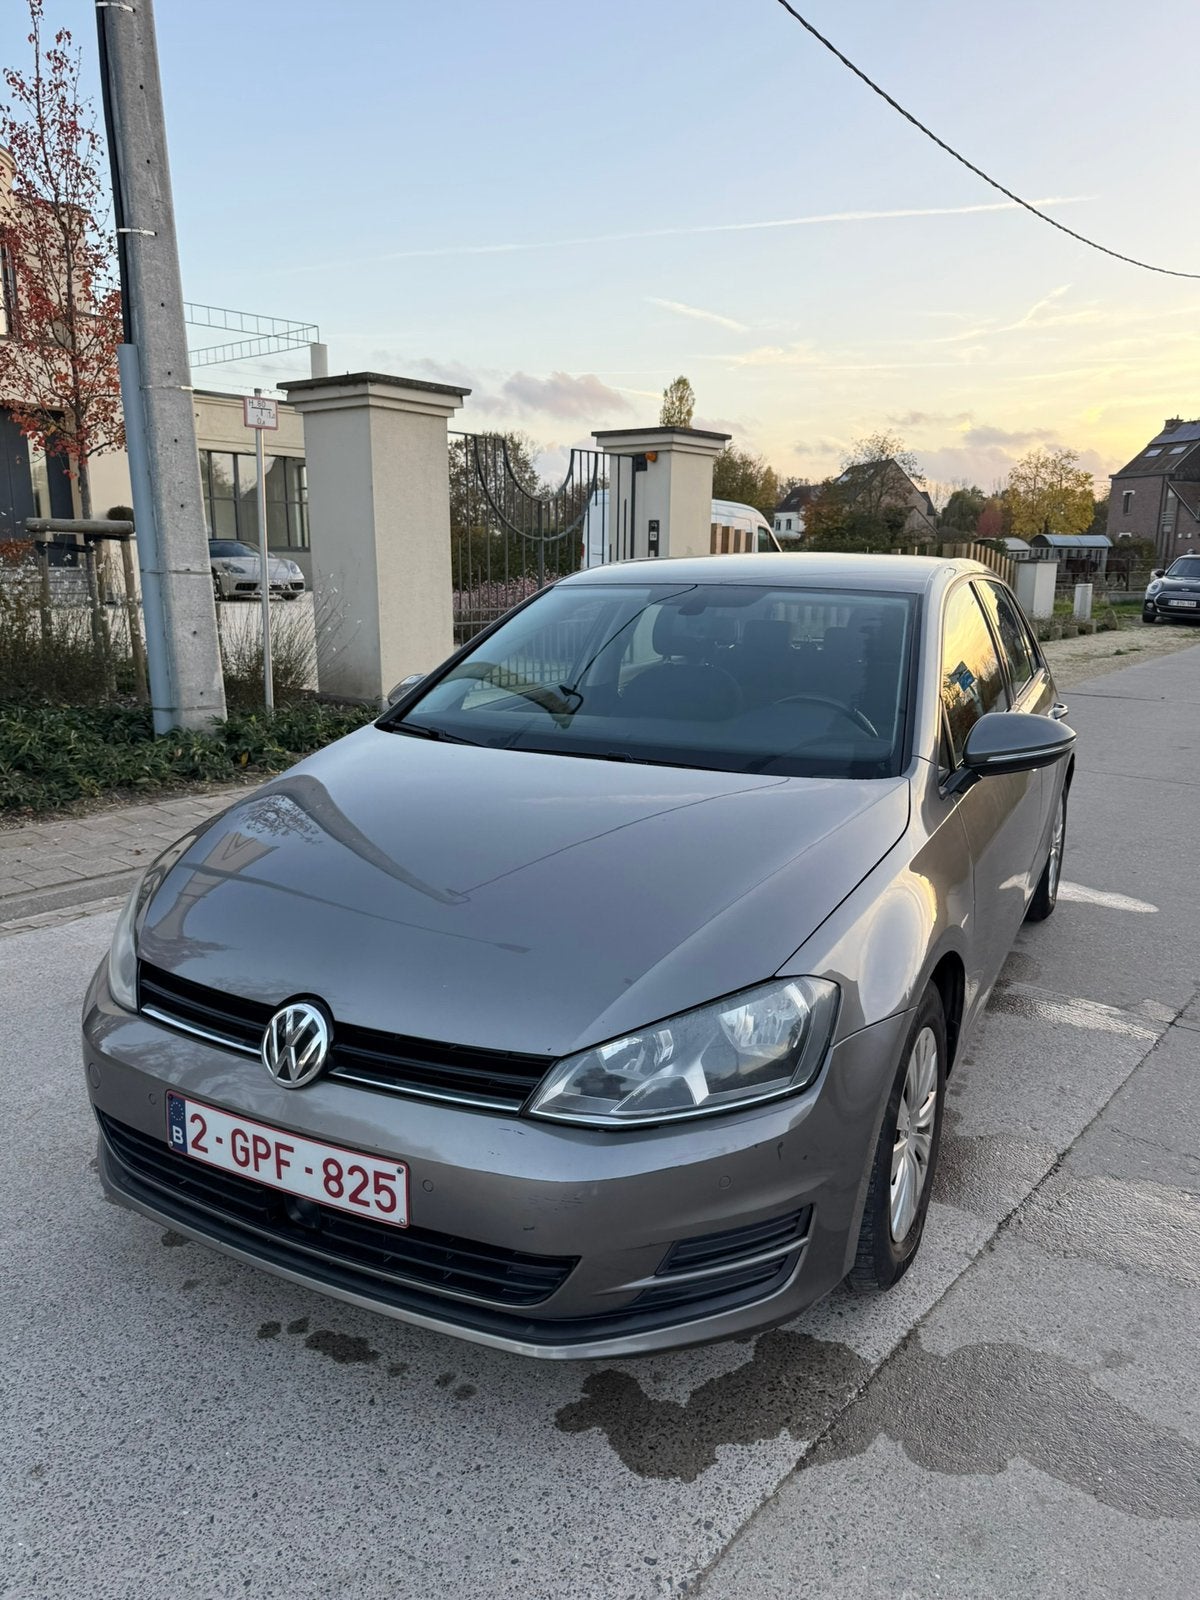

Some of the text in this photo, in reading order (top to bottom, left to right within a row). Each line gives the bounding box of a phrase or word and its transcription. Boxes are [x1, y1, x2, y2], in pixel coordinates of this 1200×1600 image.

[261, 1002, 328, 1089] VW
[172, 1125, 184, 1145] B
[189, 1113, 398, 1214] 2-GPF-825
